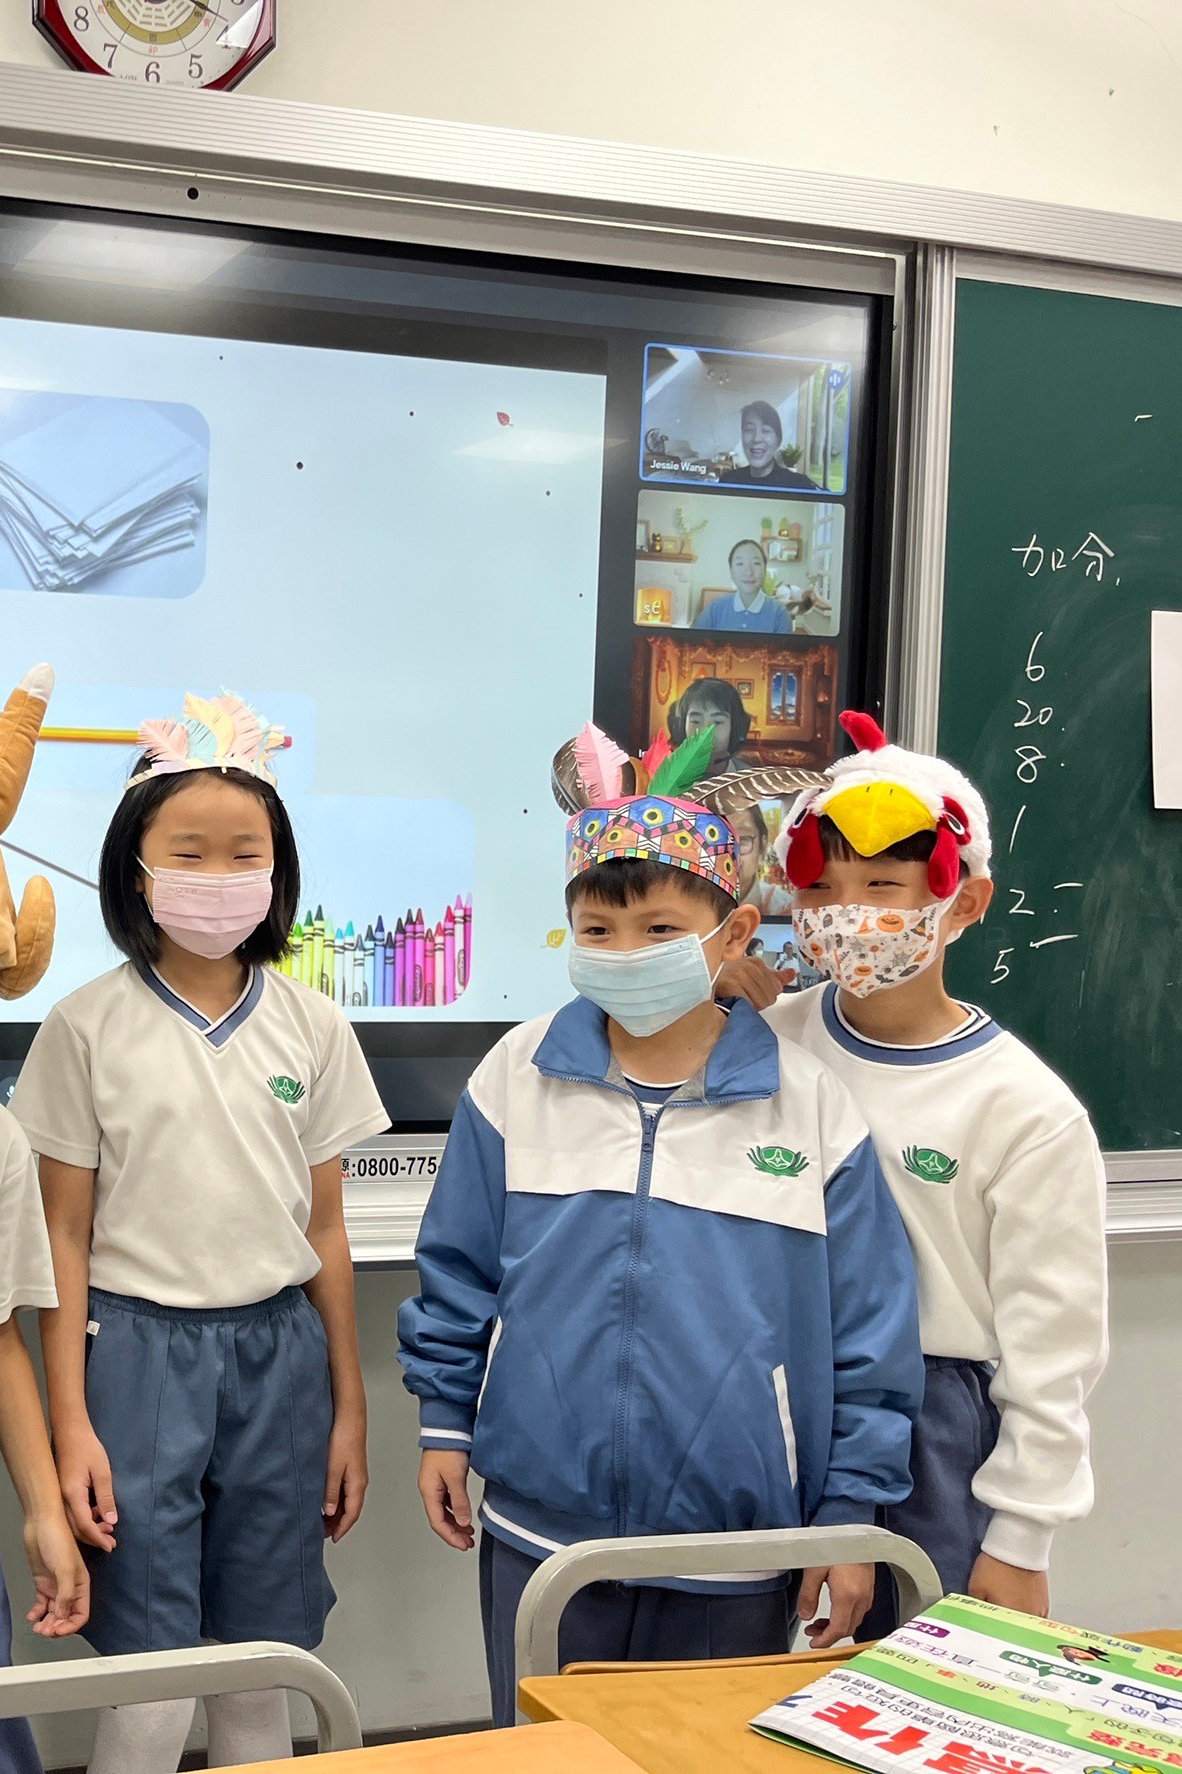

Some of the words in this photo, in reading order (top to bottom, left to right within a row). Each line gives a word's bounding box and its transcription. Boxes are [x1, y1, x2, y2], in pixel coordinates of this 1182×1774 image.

[73, 5, 90, 32] 8
[102, 43, 118, 68] 7
[188, 53, 204, 79] 5
[144, 61, 161, 83] 6
[650, 459, 679, 472] Jessie
[681, 461, 707, 475] Wang
[1026, 631, 1046, 682] 6
[990, 947, 1015, 984] 5
